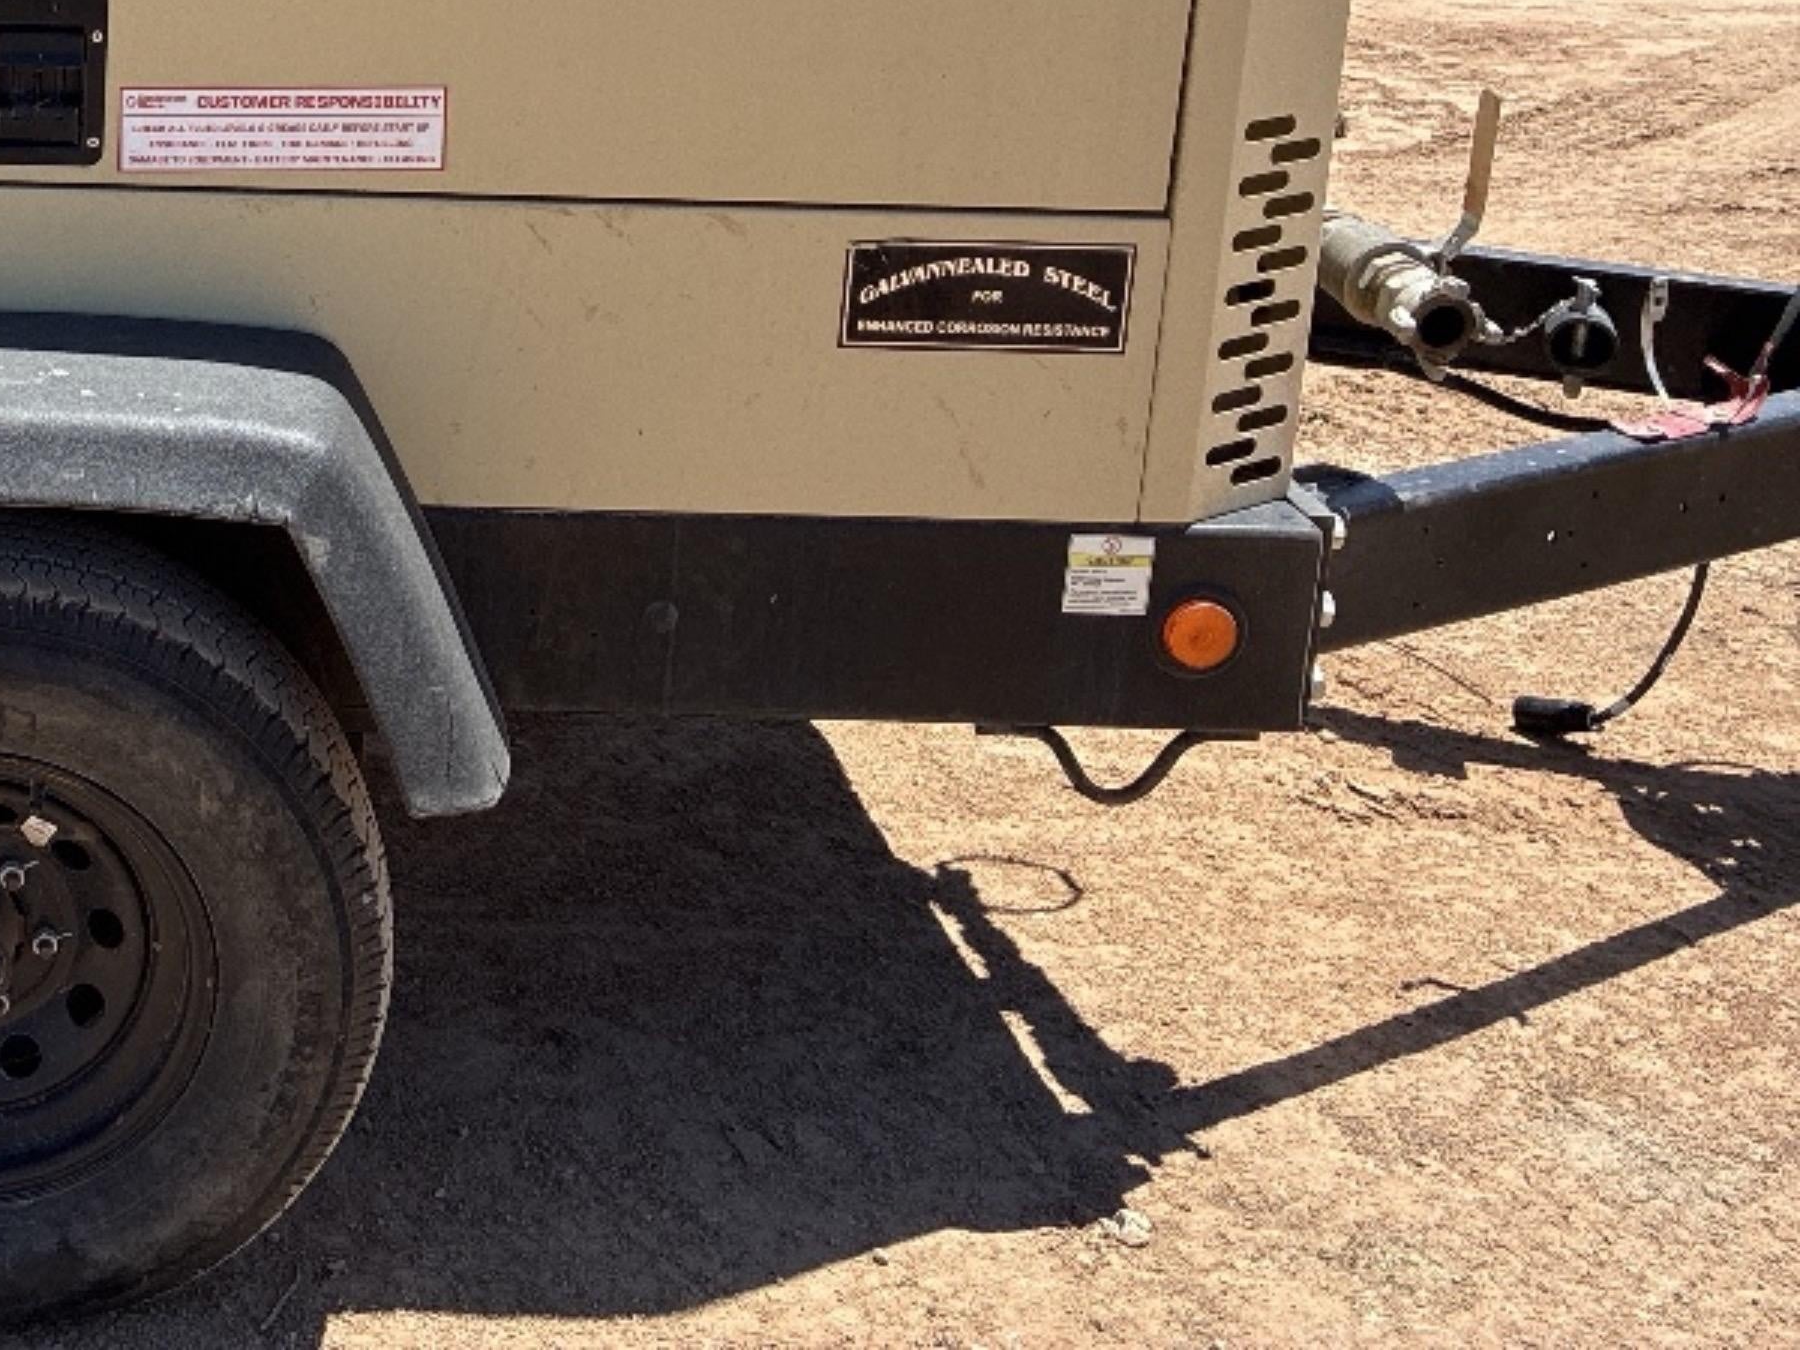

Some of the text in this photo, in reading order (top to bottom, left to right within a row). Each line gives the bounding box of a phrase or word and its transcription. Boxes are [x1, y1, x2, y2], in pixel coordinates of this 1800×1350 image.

[196, 94, 291, 110] CUSTOMER
[294, 95, 443, 110] RESPONSIBILITY
[971, 289, 1003, 304] FOR
[1042, 264, 1119, 313] STEEL
[856, 319, 934, 335] ENHANCED
